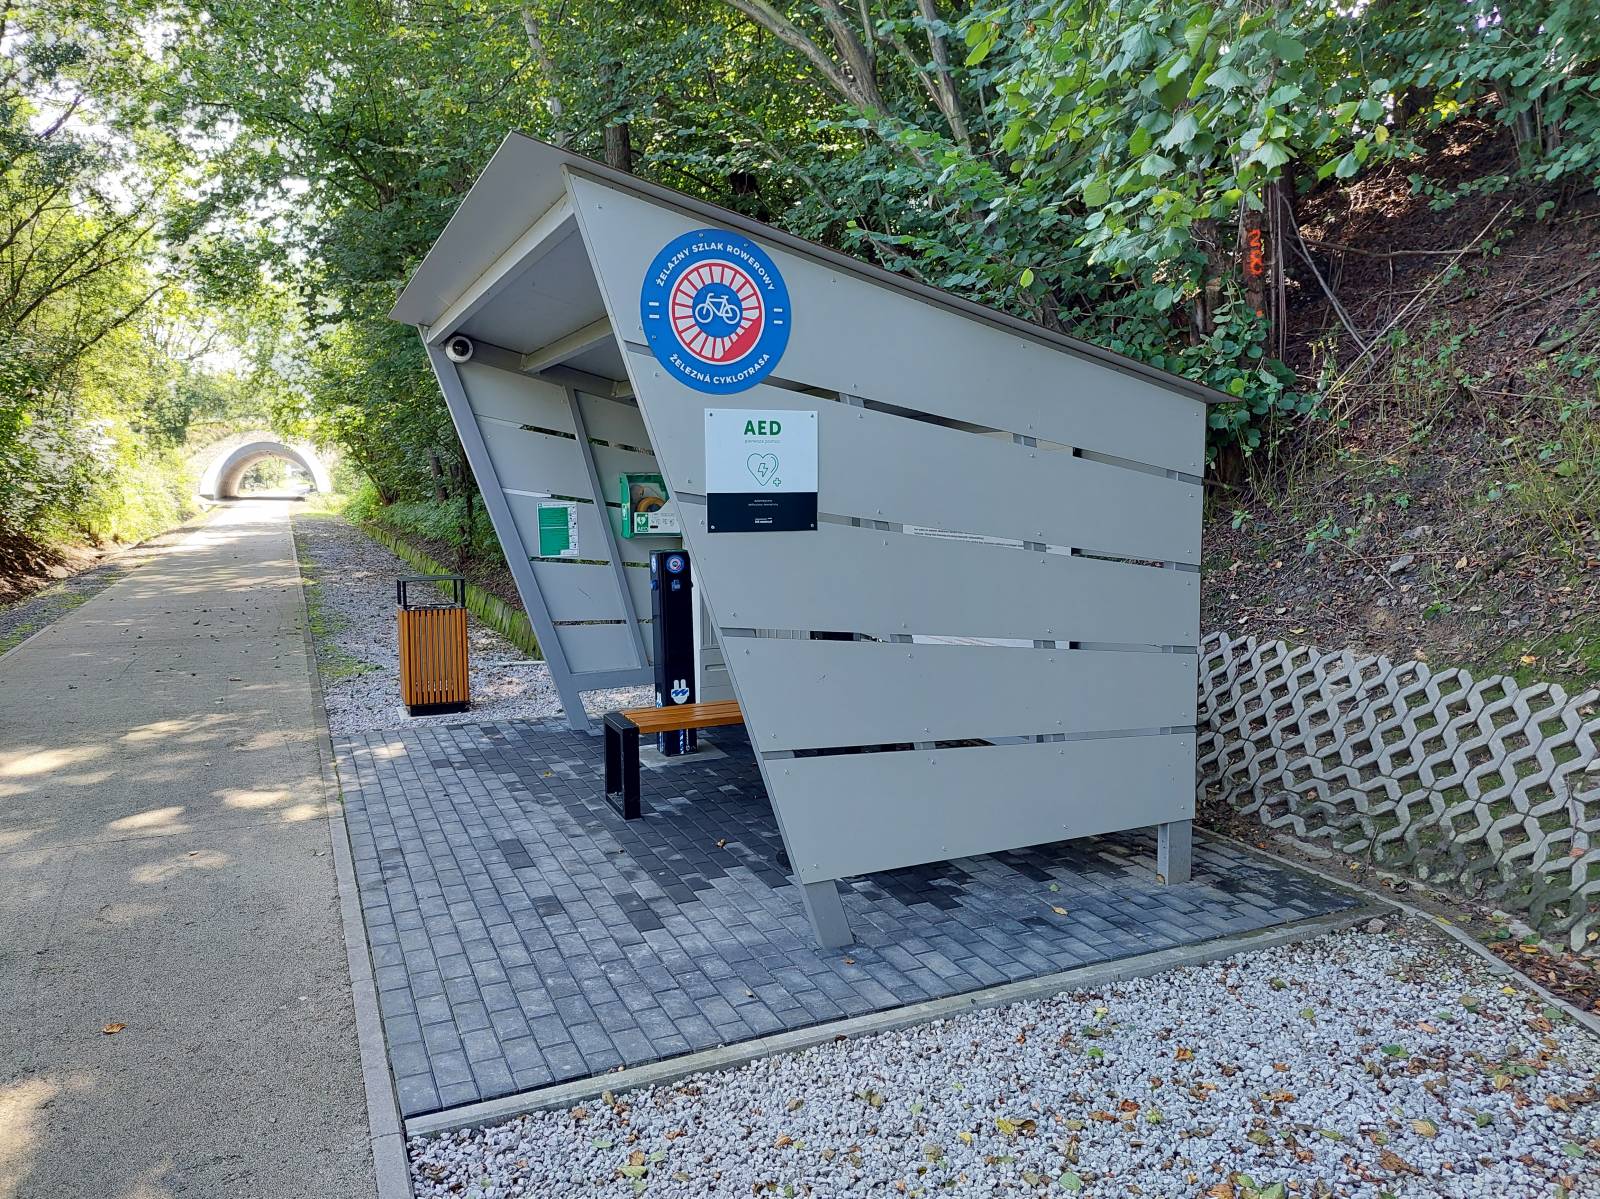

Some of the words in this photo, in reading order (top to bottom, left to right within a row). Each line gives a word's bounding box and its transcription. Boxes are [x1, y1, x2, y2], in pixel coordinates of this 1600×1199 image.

[656, 248, 689, 287] ŻELAZNY
[692, 242, 724, 252] SZLAK
[726, 245, 775, 290] ROWEROWY
[713, 353, 770, 384] CYKLOTRASA
[744, 420, 781, 435] AED
